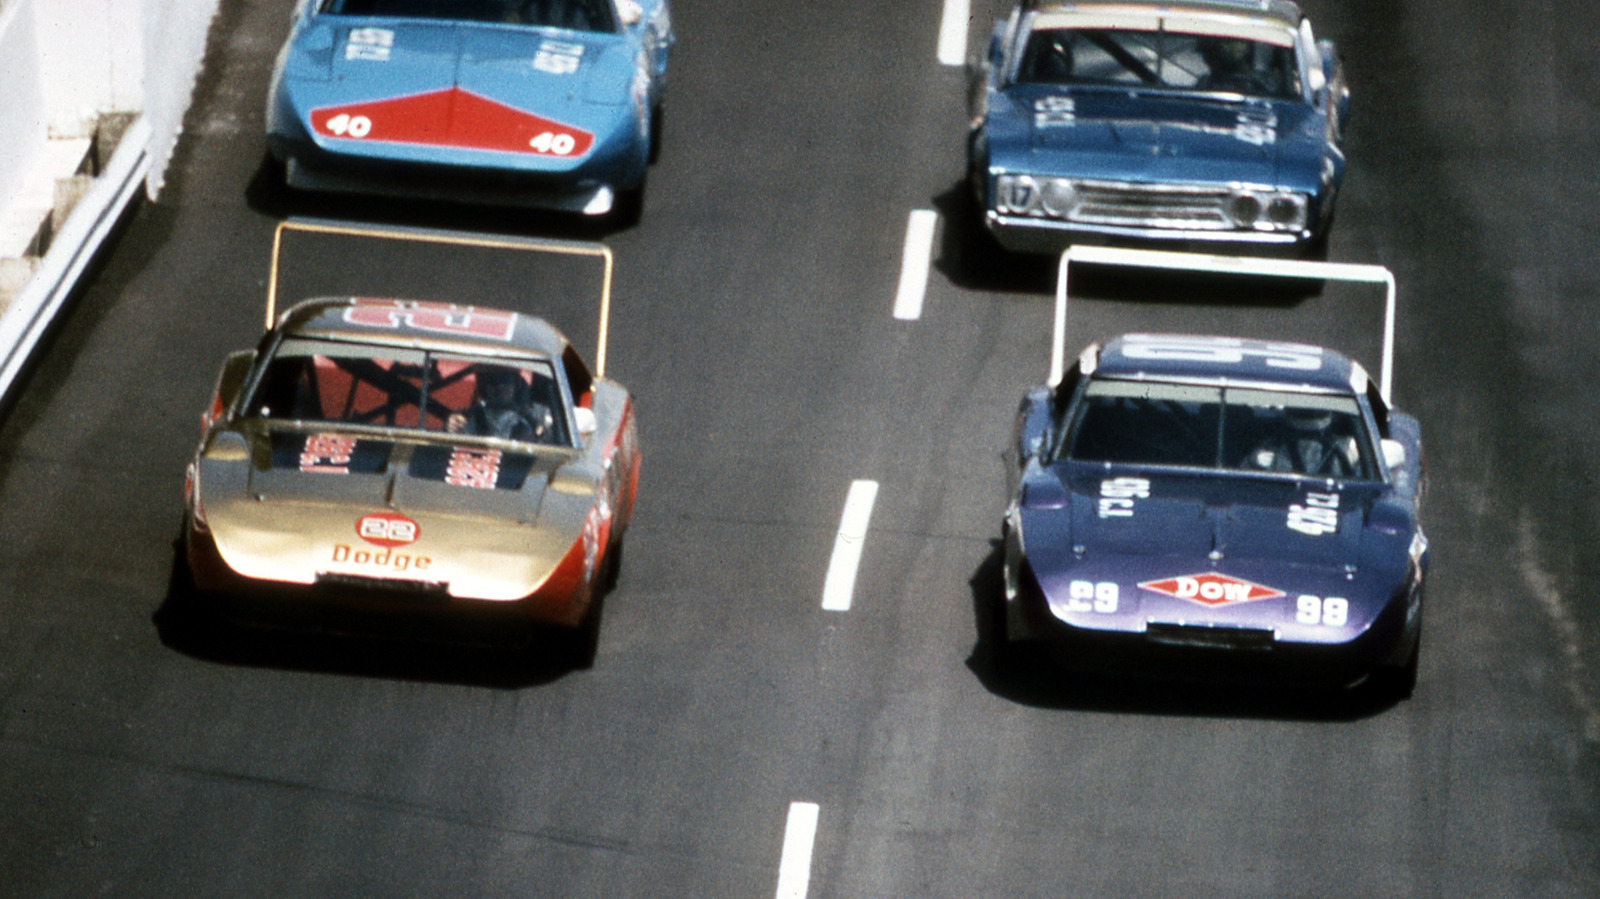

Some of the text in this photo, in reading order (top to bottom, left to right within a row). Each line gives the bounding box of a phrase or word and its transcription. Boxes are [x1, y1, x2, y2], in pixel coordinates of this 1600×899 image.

[326, 114, 372, 137] 40
[529, 132, 575, 155] 40
[1011, 184, 1031, 206] 17
[360, 517, 416, 542] 22
[1287, 504, 1337, 535] 426
[332, 544, 431, 571] Dodge
[1067, 580, 1119, 613] 99
[1174, 577, 1253, 601] DOW
[1297, 595, 1349, 627] 99
